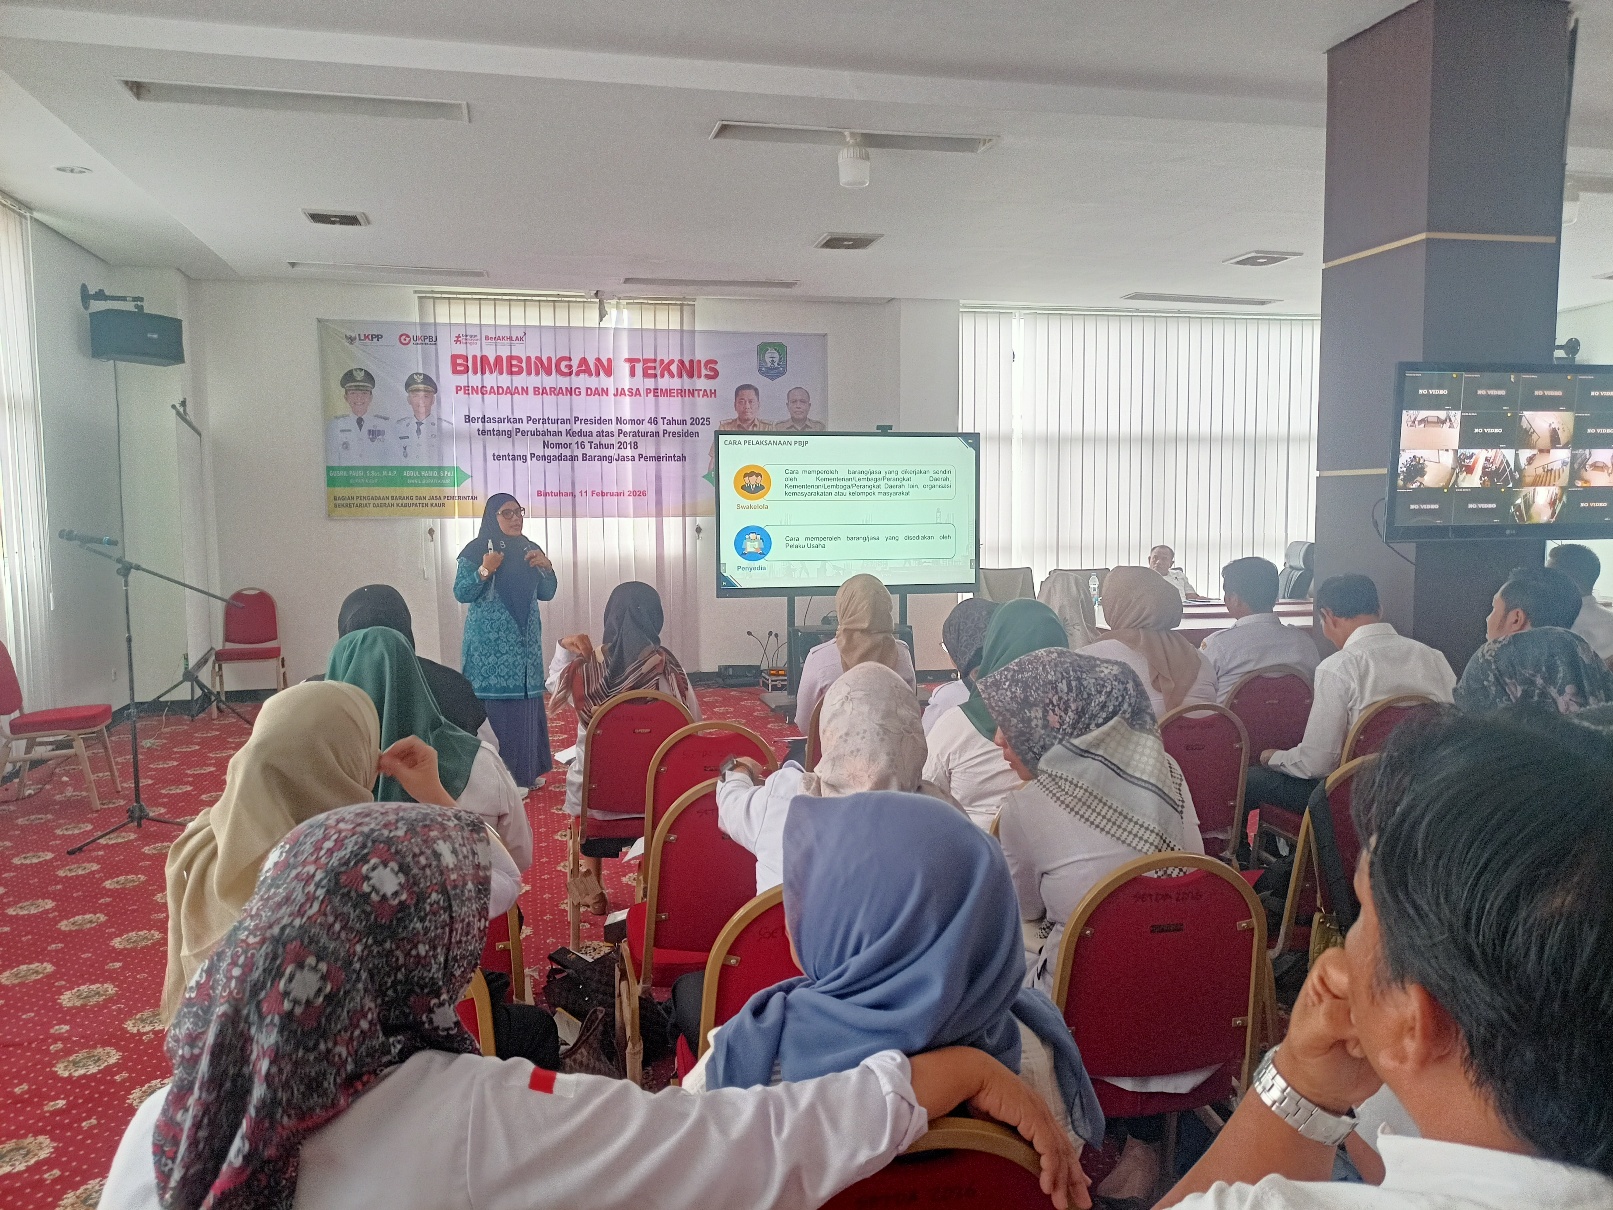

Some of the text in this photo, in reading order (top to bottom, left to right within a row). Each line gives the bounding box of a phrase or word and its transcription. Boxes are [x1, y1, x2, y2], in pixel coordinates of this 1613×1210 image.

[358, 334, 384, 342] LKPP
[450, 354, 720, 380] BIMBINGAN TEKNIS
[455, 386, 716, 398] PENGADAAN BARANG DAN JASA PEMERINTAH
[464, 414, 710, 426] Berdasarkan Peraturan Presiden Nomor 46 Tahun 2025
[477, 428, 700, 438] tentang Perubahan Kedua atas Peraturan Presiden
[542, 440, 638, 450] Nomor 16 Tahun 2018
[492, 453, 686, 464] tentang Pengadaan Barang/Jasa Pemerintah
[536, 490, 576, 498] Bintuhan,
